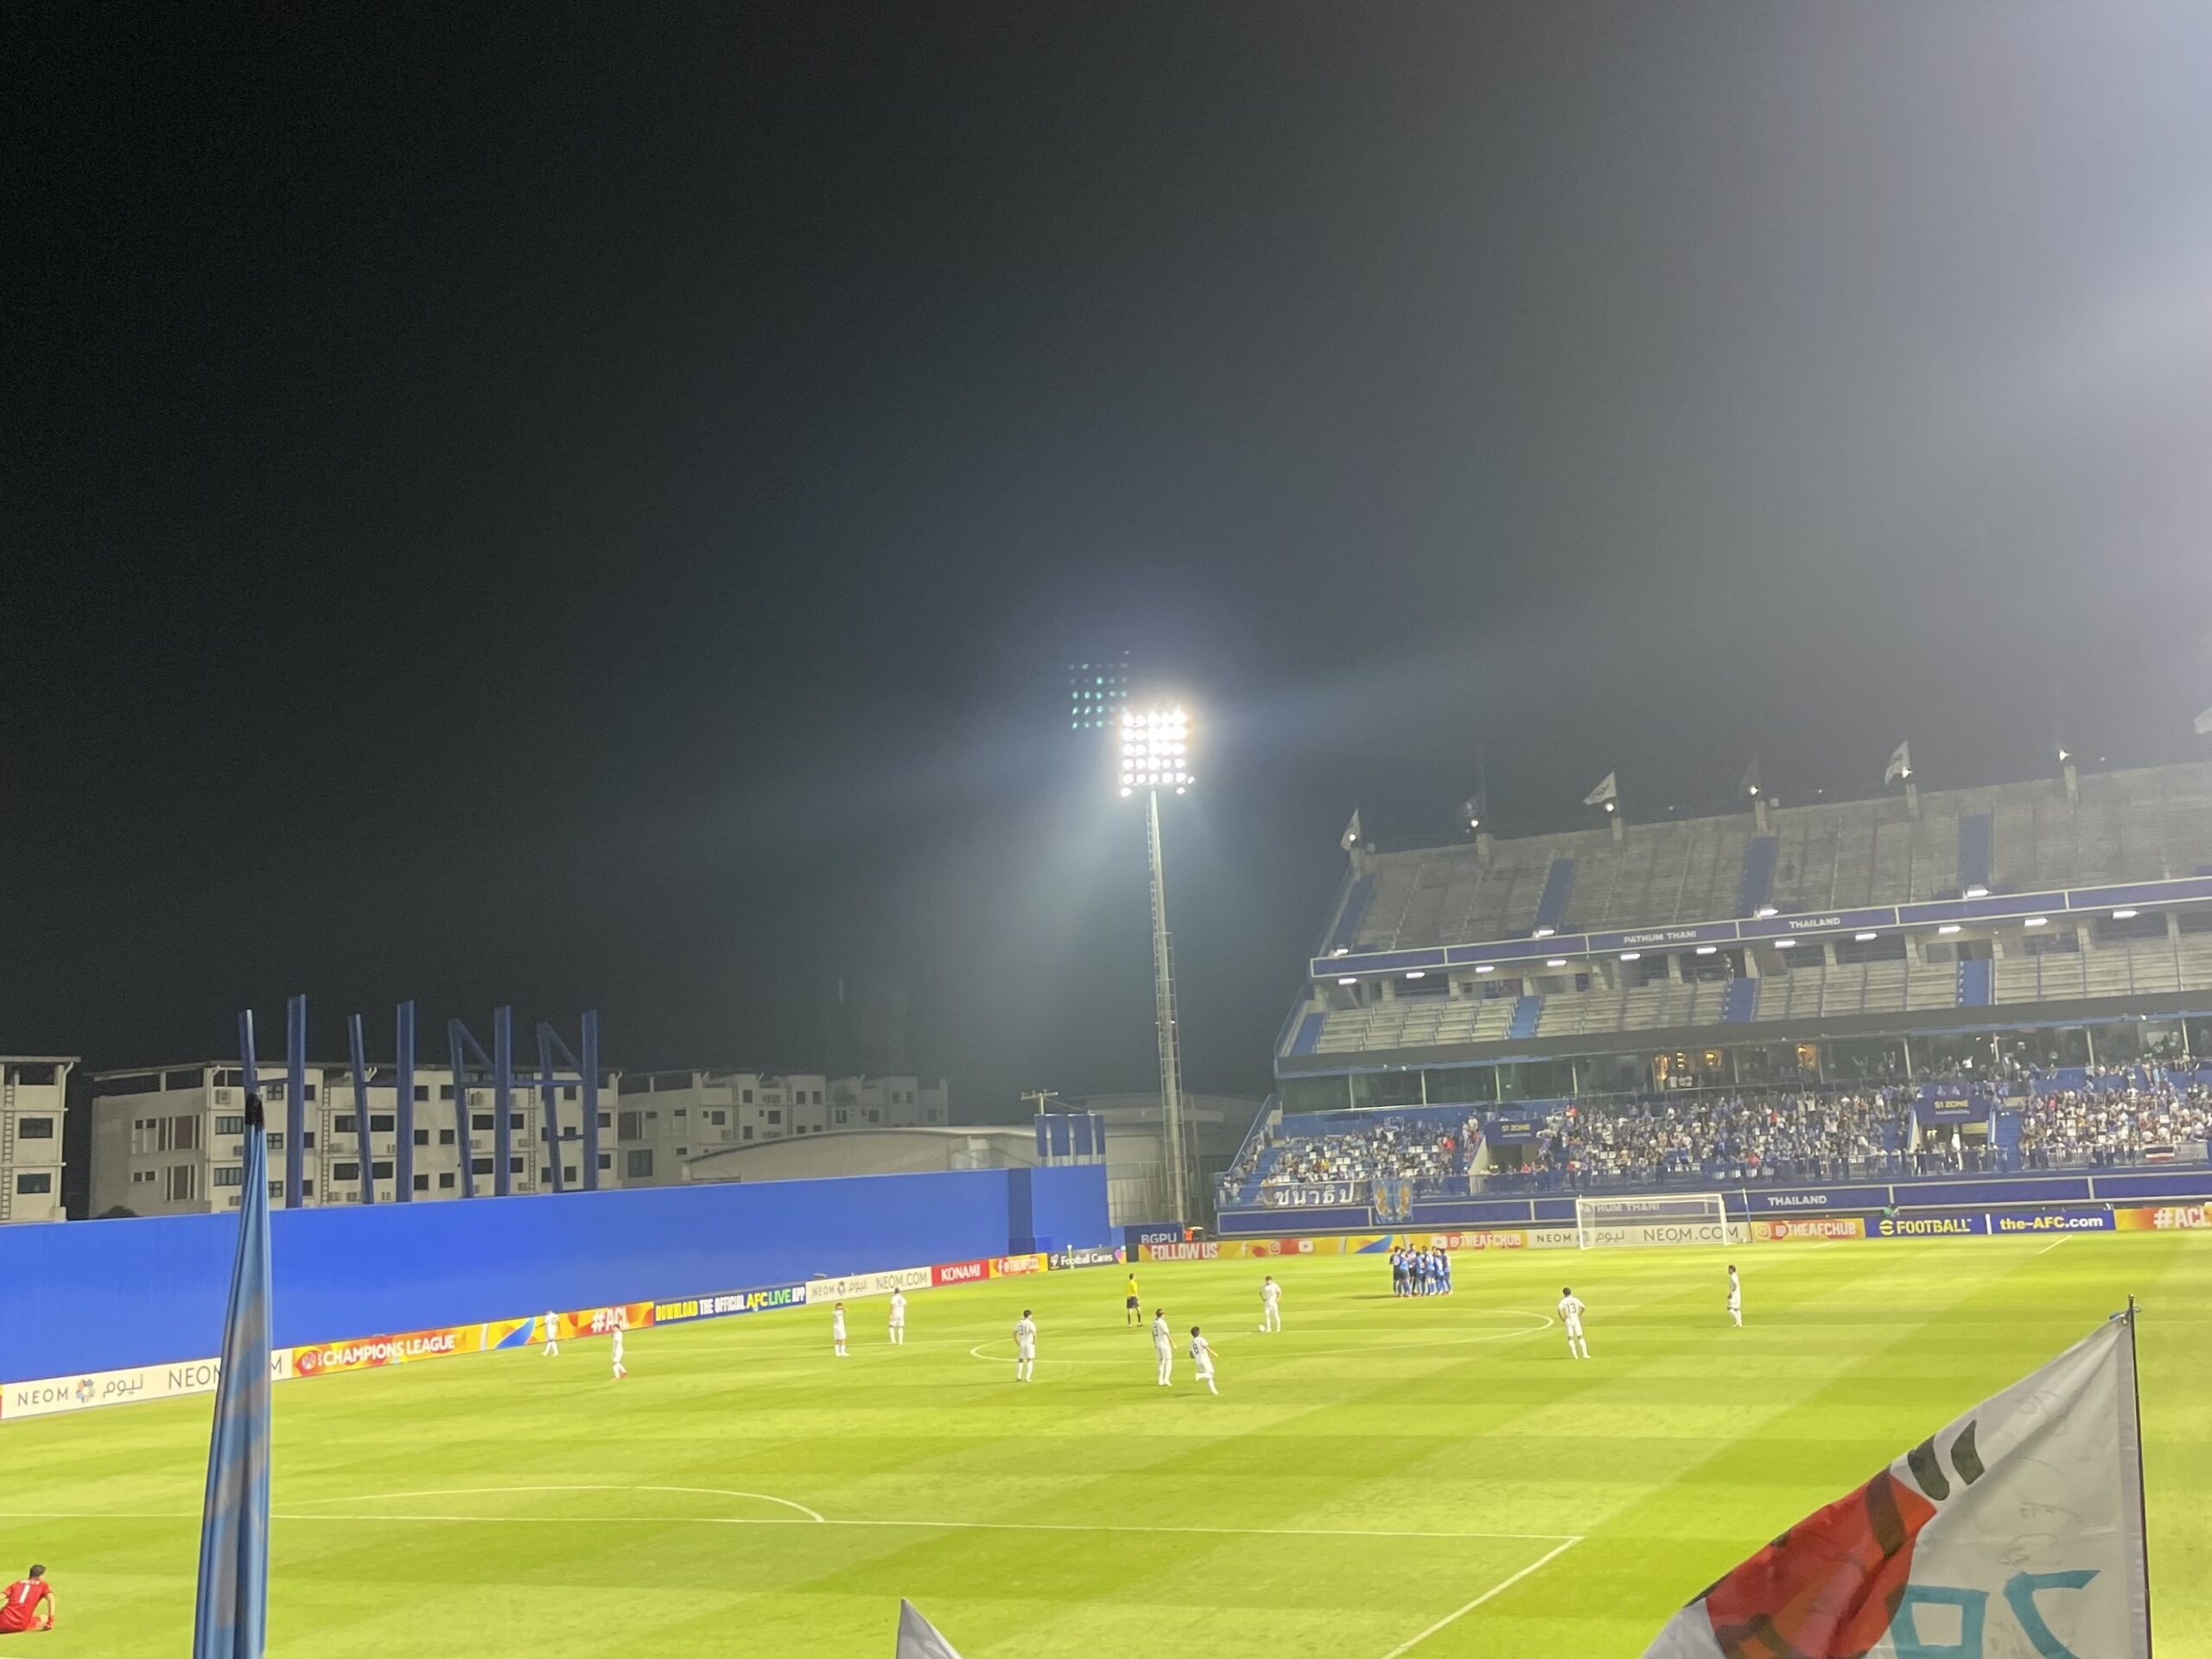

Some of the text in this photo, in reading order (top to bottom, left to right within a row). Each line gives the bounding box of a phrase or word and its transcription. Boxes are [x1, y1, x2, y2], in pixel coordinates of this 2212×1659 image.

[1789, 918, 1840, 929] THAILAND
[1666, 931, 1697, 940] THANI
[1274, 1182, 1355, 1205] ชนาธิป
[1768, 1195, 1827, 1206] THAILAND
[1776, 1222, 1857, 1236] @THEAFCHUB
[1999, 1216, 2104, 1230] the-AFC.com
[1141, 1232, 1177, 1244] BGPU
[1536, 1233, 1572, 1243] NEOM
[1643, 1225, 1739, 1242] NEOM.COM
[1060, 1253, 1114, 1266] Football Cares
[1151, 1243, 1218, 1261] FOLLOW US
[940, 1263, 981, 1281] KONAMI
[876, 1271, 927, 1291] NEOM.COM
[812, 1285, 835, 1296] NEOM
[655, 1287, 805, 1321] DOWNLOAD THE OFFICIAL AFC LIVE APP
[1567, 1302, 1577, 1314] 13
[590, 1306, 631, 1334] #ACL
[323, 1341, 404, 1367] CHAMPIONS
[407, 1334, 456, 1356] LEAGUE
[1192, 1343, 1199, 1355] 8
[103, 1373, 144, 1399] نيوم
[17, 1386, 69, 1407] NEOM
[19, 1584, 31, 1604] 1
